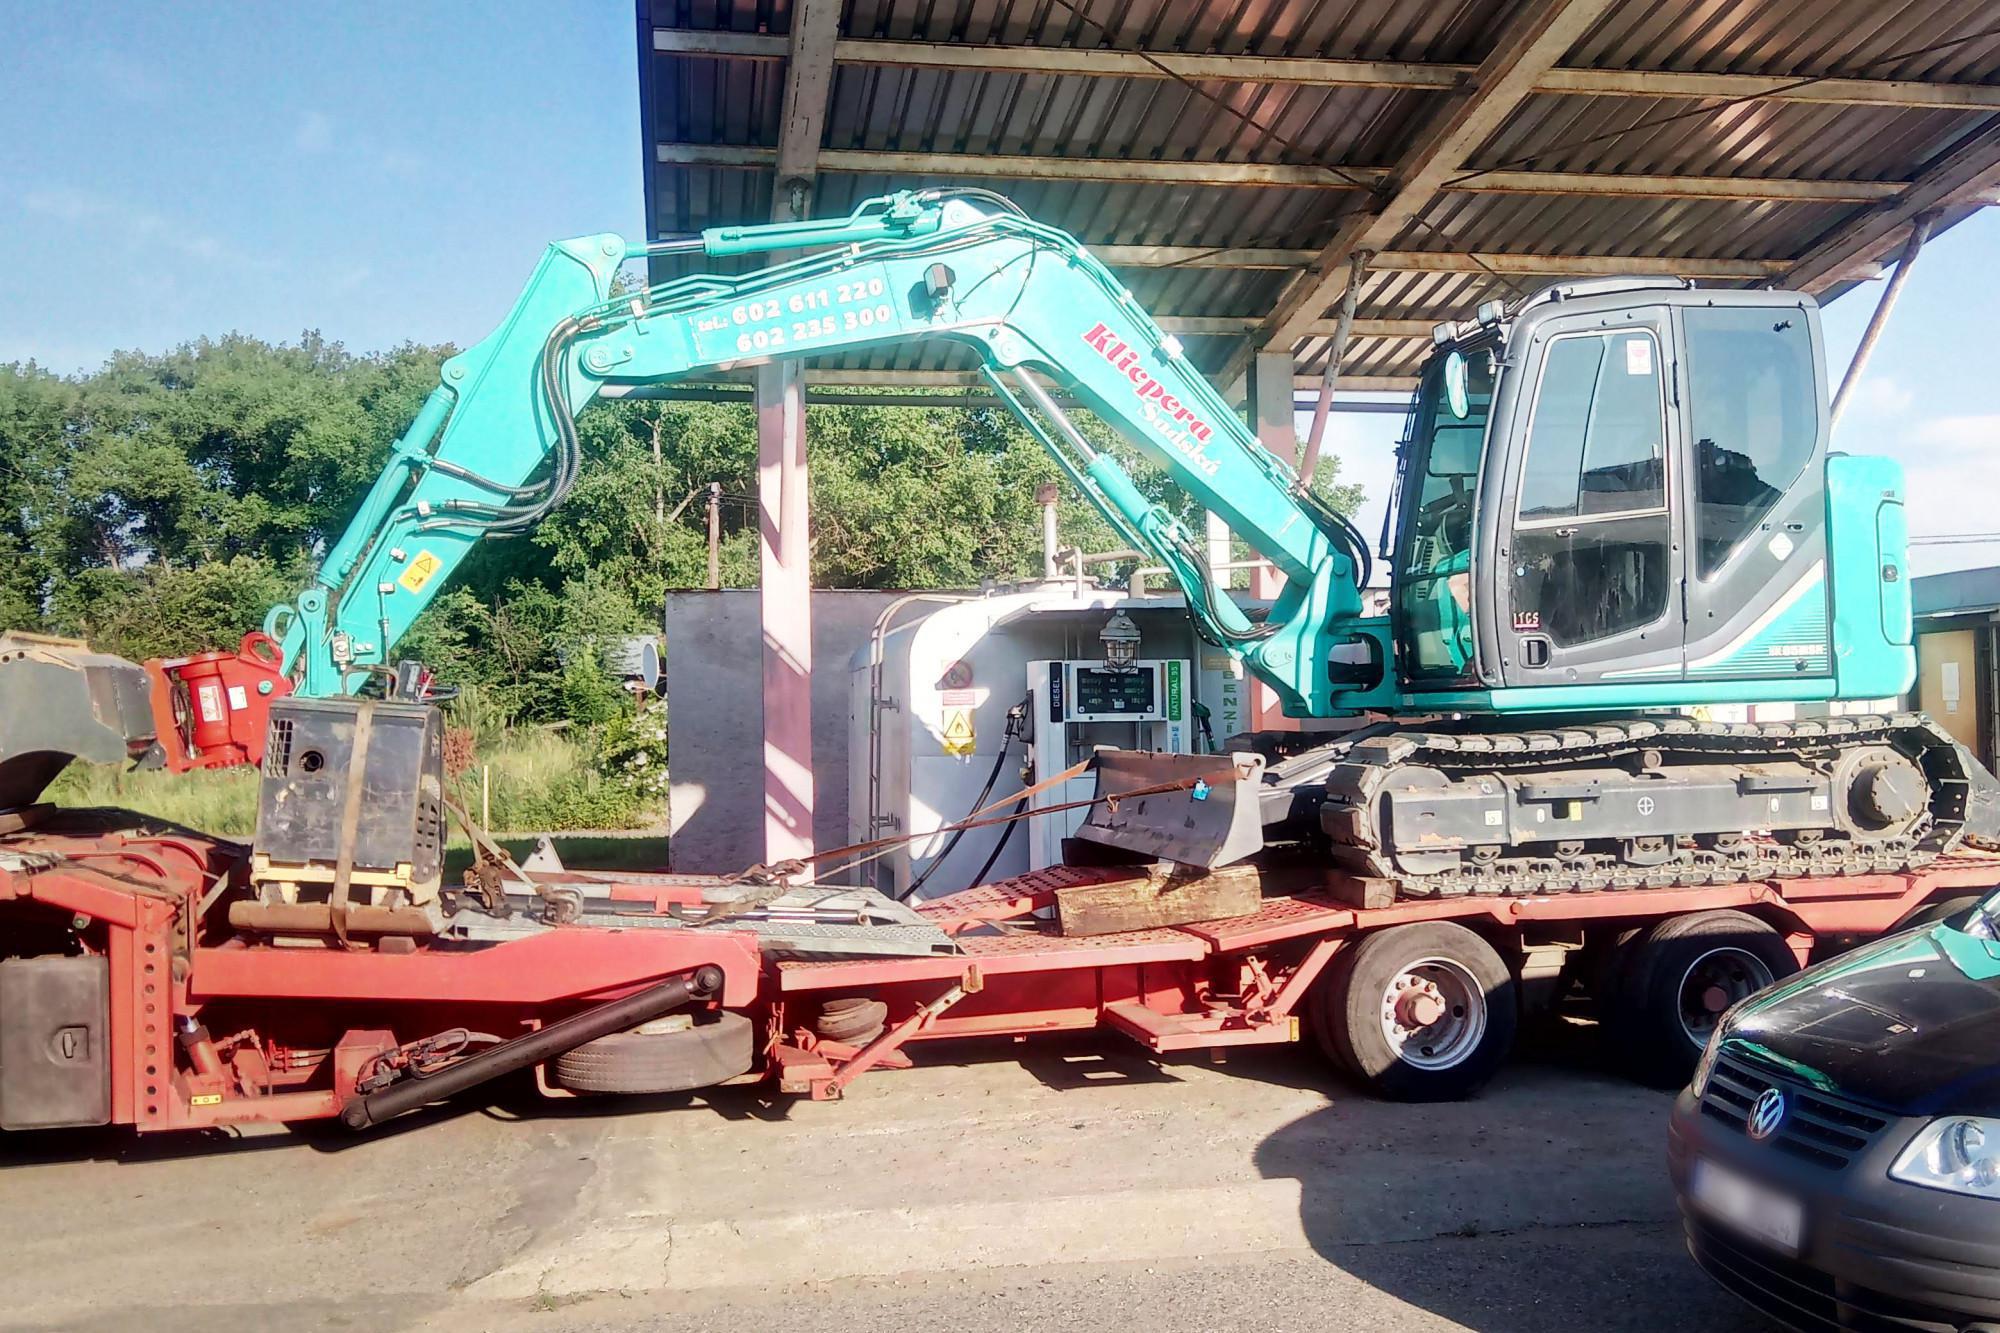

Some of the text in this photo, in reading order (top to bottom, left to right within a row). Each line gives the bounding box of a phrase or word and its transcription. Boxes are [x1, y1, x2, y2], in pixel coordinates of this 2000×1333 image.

[732, 299, 781, 325] 602
[788, 287, 830, 314] 611
[837, 277, 884, 304] 220
[736, 304, 892, 353] 602 235 300
[1082, 321, 1214, 443] Klicpera
[1052, 677, 1061, 708] DIESEL
[1171, 666, 1179, 716] NATURAL 95
